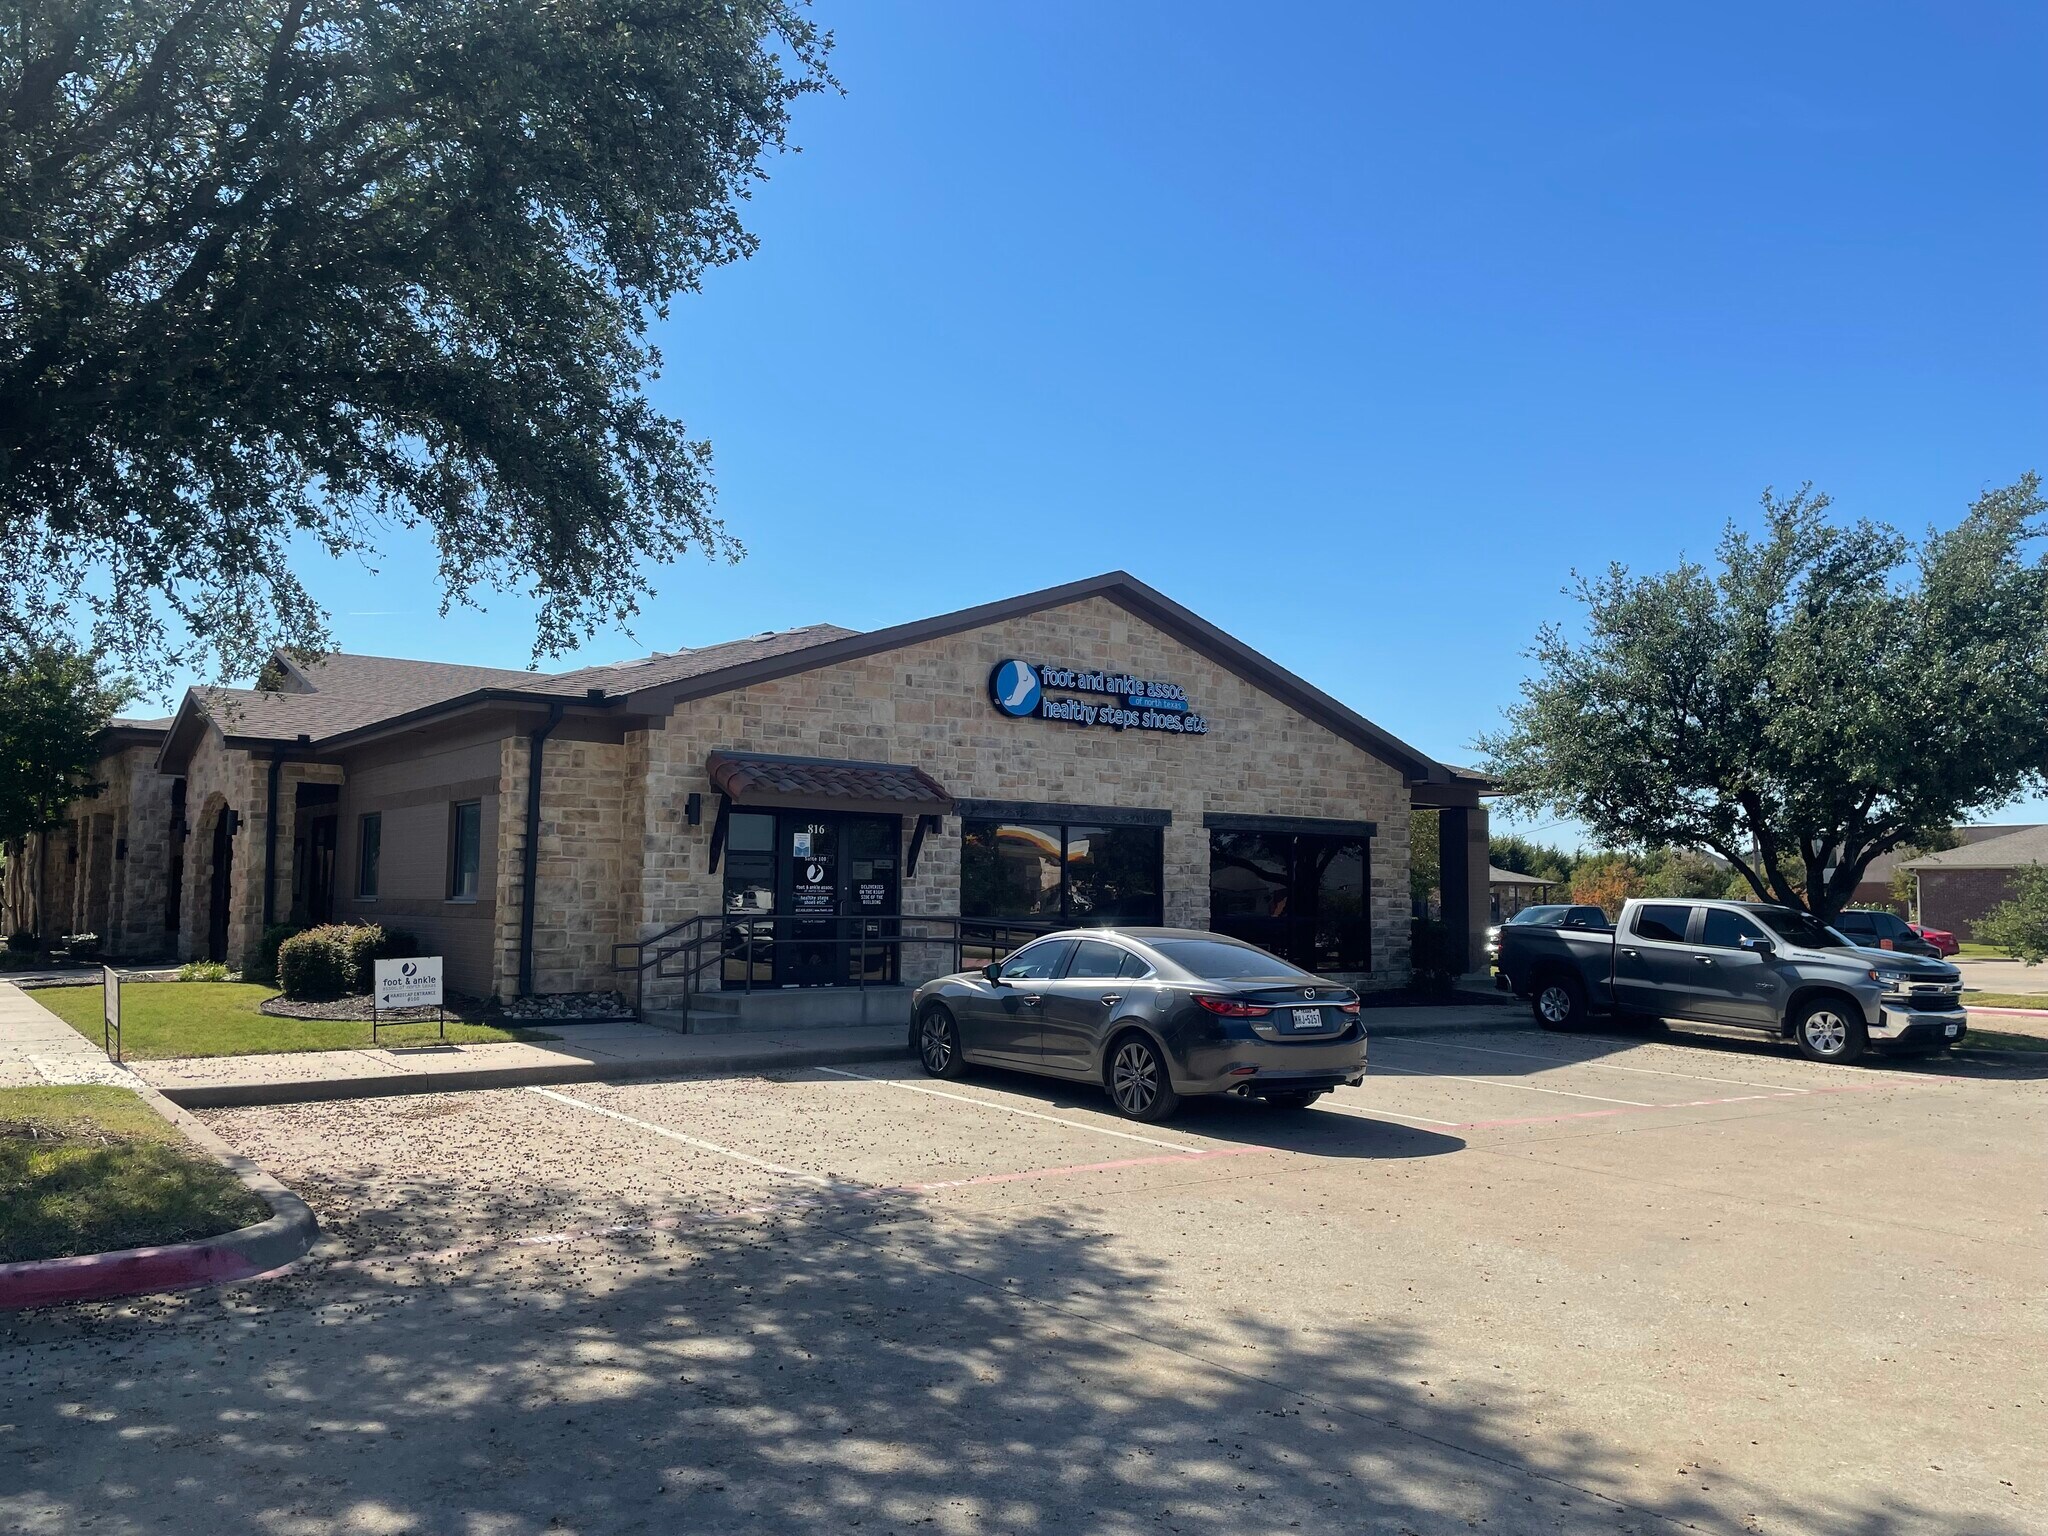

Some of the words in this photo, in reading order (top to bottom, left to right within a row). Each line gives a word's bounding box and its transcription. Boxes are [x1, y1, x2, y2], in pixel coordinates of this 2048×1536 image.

[1041, 666, 1076, 688] foot
[1078, 671, 1104, 691] and
[1106, 674, 1144, 696] ankle
[1147, 682, 1188, 701] assoc.
[1135, 698, 1143, 706] of
[1144, 699, 1162, 707] north
[1164, 700, 1182, 709] texas
[1042, 697, 1098, 725] healthy
[1099, 705, 1139, 730] steps
[808, 824, 825, 834] 816
[382, 978, 402, 986] foot
[405, 977, 411, 985] &
[413, 976, 436, 984] ankle
